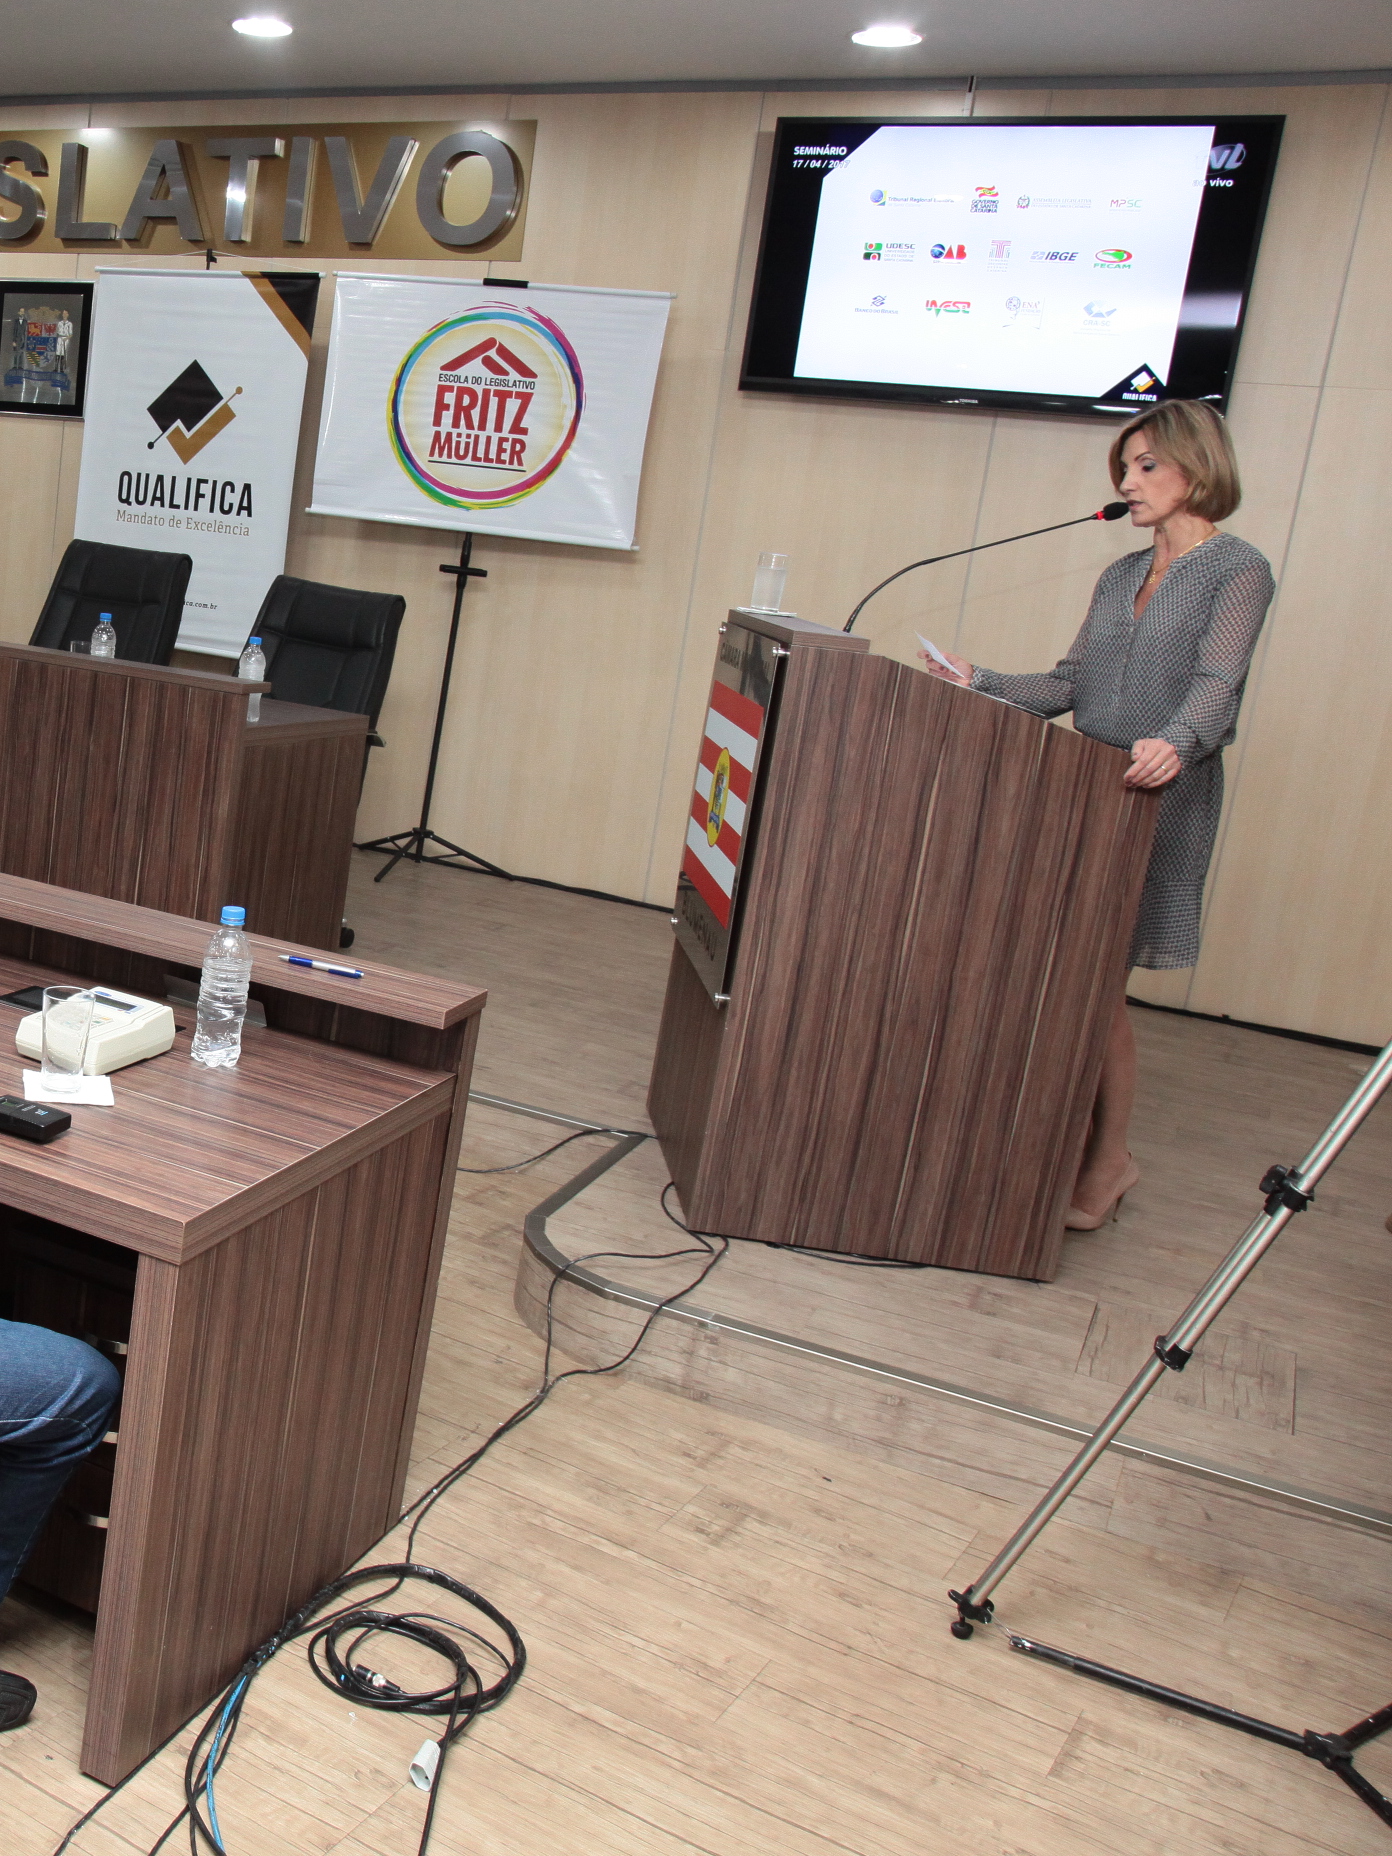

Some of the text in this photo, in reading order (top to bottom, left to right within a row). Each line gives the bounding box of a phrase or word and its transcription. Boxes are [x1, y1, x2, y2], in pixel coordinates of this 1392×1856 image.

[793, 144, 847, 156] SEMINÁRIO
[1210, 177, 1234, 187] vivo
[1044, 251, 1079, 262] IBGE
[438, 373, 536, 390] ESCOLA DO LEGISLATIVO
[432, 384, 534, 436] FRITZ
[428, 430, 527, 467] MÜLLER
[117, 470, 253, 518] QUALIFICA
[116, 509, 251, 537] Mandato de Excelência
[185, 600, 218, 610] ca.com.br
